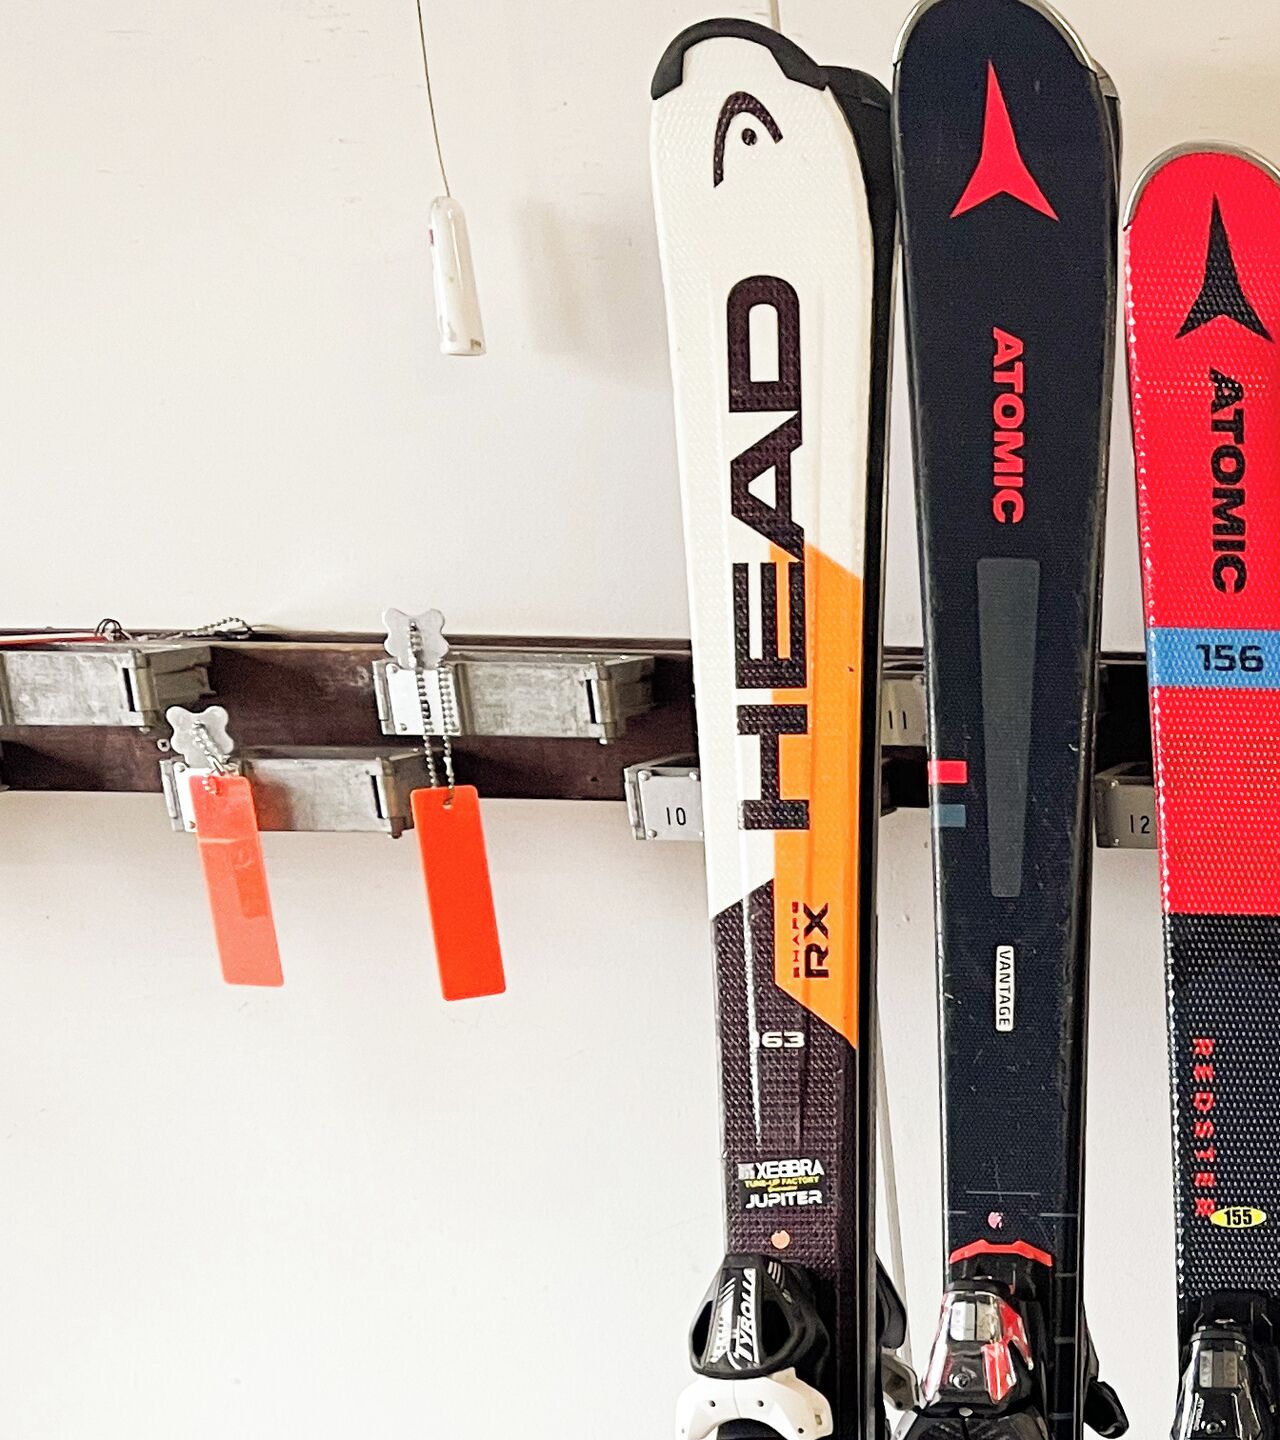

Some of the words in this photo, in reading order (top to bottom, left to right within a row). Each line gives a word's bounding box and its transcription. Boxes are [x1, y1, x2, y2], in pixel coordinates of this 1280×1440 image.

[992, 326, 1026, 525] ATOMIC
[1208, 367, 1248, 594] ATOMIC
[727, 275, 810, 830] HEAD
[1197, 644, 1265, 673] 156
[888, 710, 908, 730] 11
[665, 806, 687, 827] 10
[1129, 815, 1151, 834] 12
[803, 902, 829, 978] RX
[998, 949, 1012, 1028] VANTAGE
[1192, 1038, 1216, 1217] REDSTER
[745, 1189, 823, 1209] JUPITER
[1223, 1208, 1254, 1226] 155
[736, 1267, 761, 1366] TYROLIA
